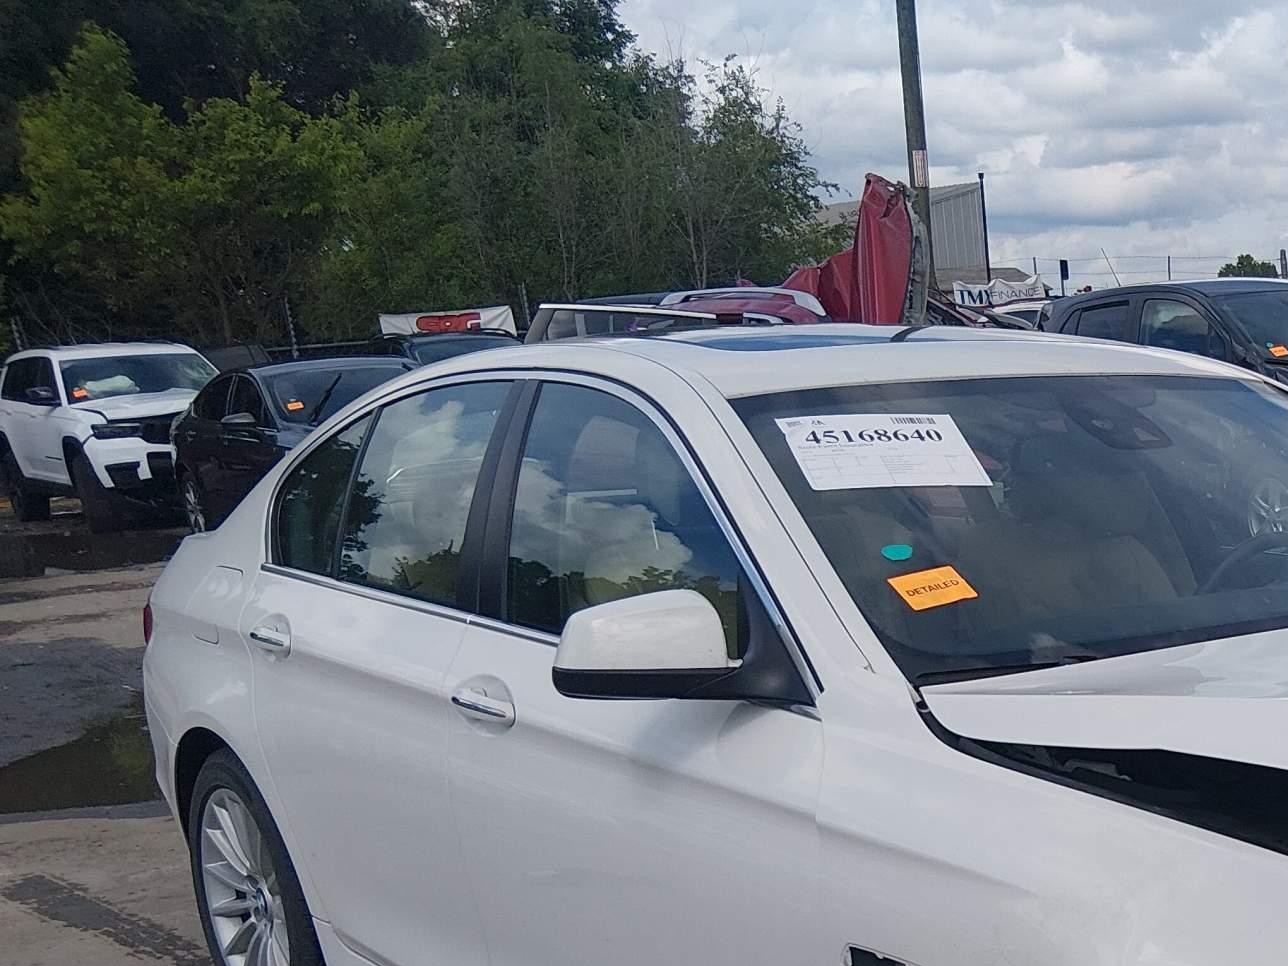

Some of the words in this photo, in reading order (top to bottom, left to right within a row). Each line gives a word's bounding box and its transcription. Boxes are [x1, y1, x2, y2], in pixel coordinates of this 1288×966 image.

[992, 287, 1041, 300] FINANCE
[804, 428, 943, 445] 45168640
[905, 579, 960, 597] DETAILED
